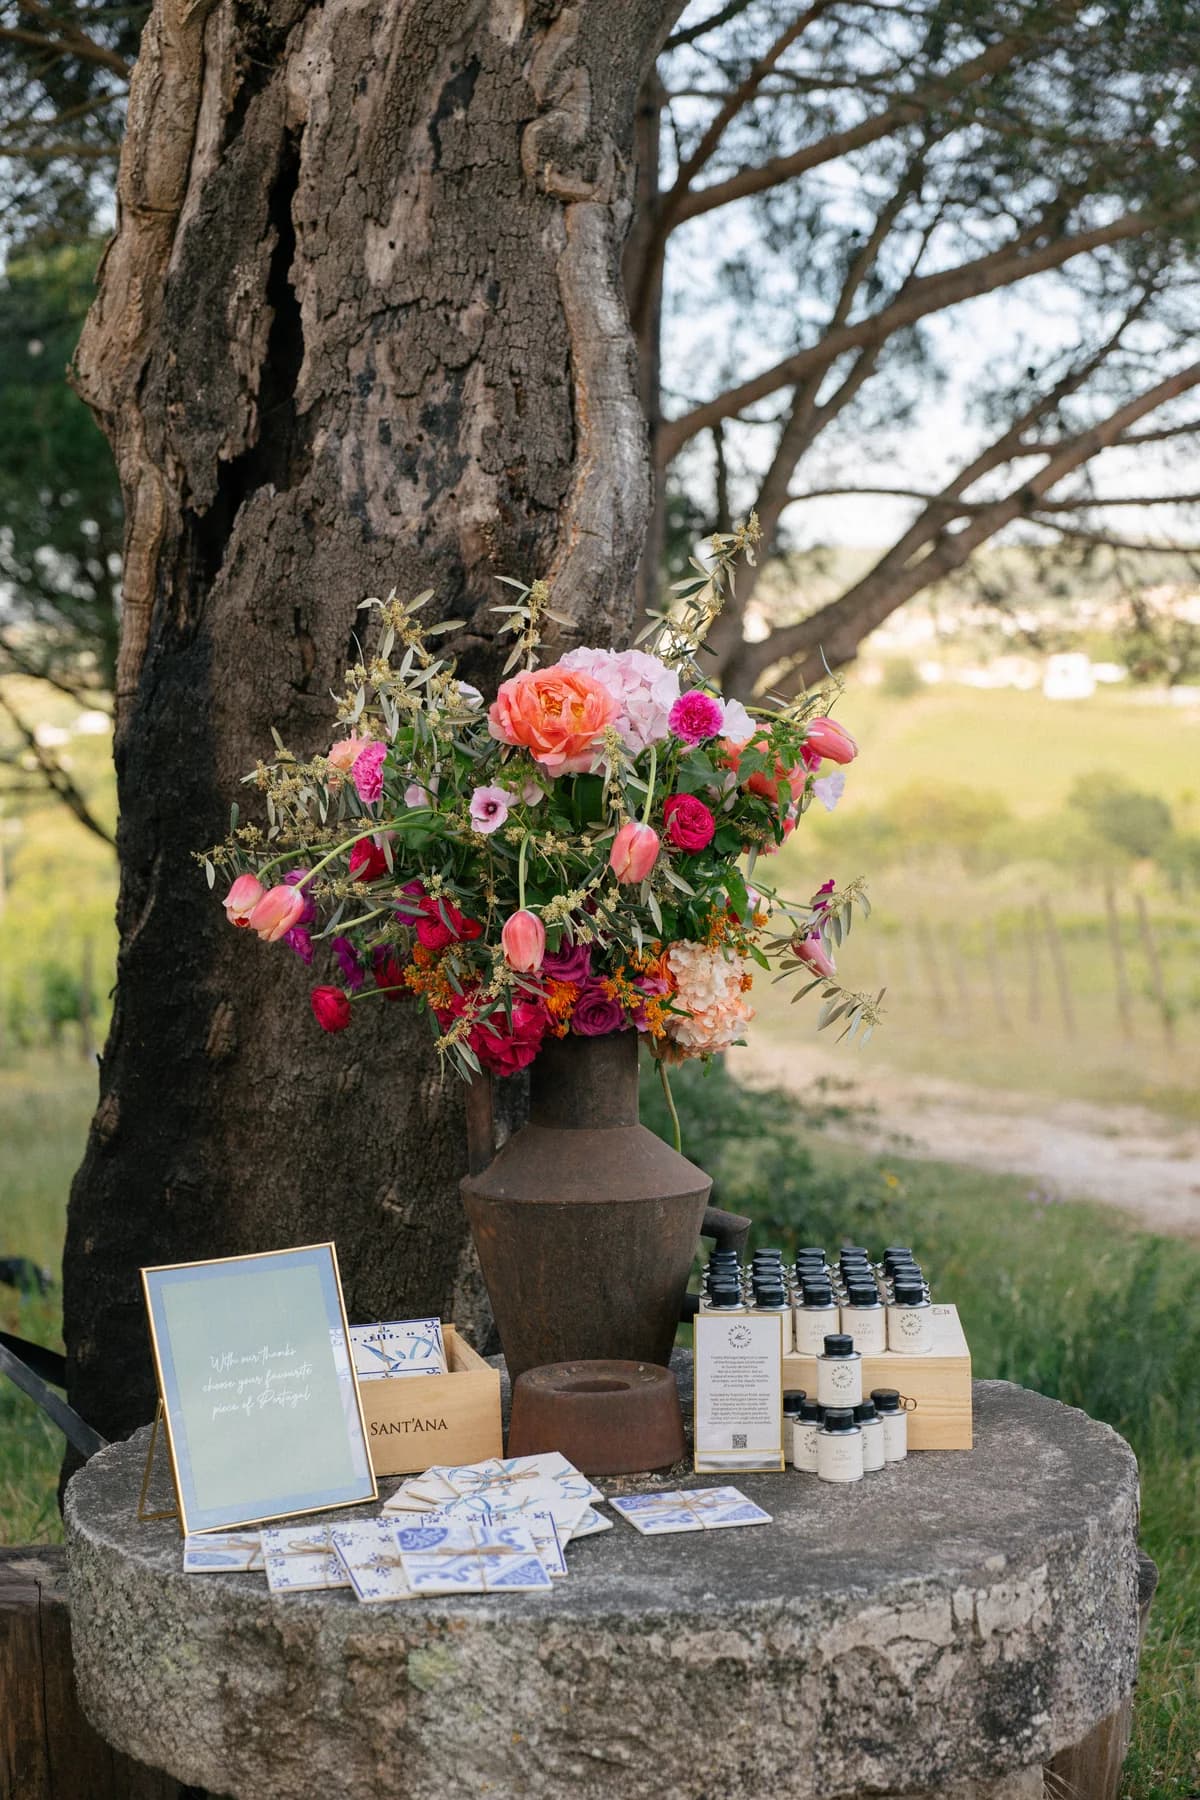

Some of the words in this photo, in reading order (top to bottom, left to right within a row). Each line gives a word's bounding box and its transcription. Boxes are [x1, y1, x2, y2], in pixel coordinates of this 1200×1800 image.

[210, 1351, 238, 1373] With
[241, 1354, 259, 1364] our
[258, 1344, 297, 1366] thanks
[202, 1376, 236, 1393] choose
[237, 1376, 262, 1394] your
[264, 1361, 312, 1389] favourite
[212, 1402, 239, 1421] piece
[242, 1395, 257, 1417] of
[257, 1384, 312, 1409] Portugal
[370, 1417, 448, 1436] SANT'ANA
